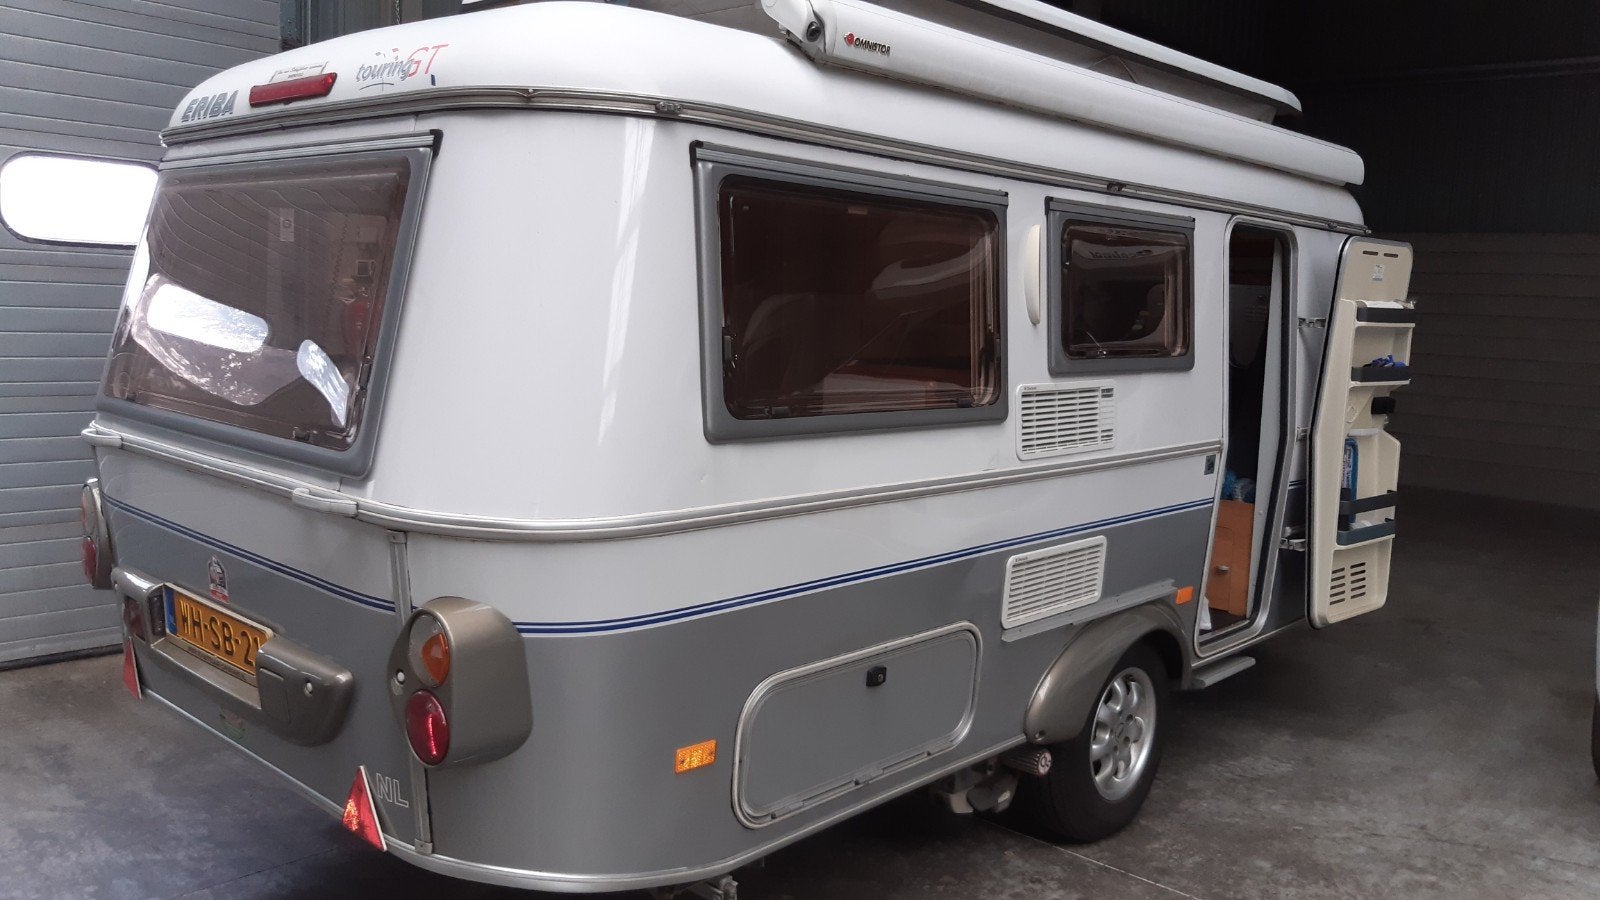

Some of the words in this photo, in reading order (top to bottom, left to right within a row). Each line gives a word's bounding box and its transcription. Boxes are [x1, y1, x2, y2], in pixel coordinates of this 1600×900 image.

[854, 37, 891, 55] OMNISTOR
[181, 89, 239, 123] ERIBA
[376, 772, 410, 808] NL
